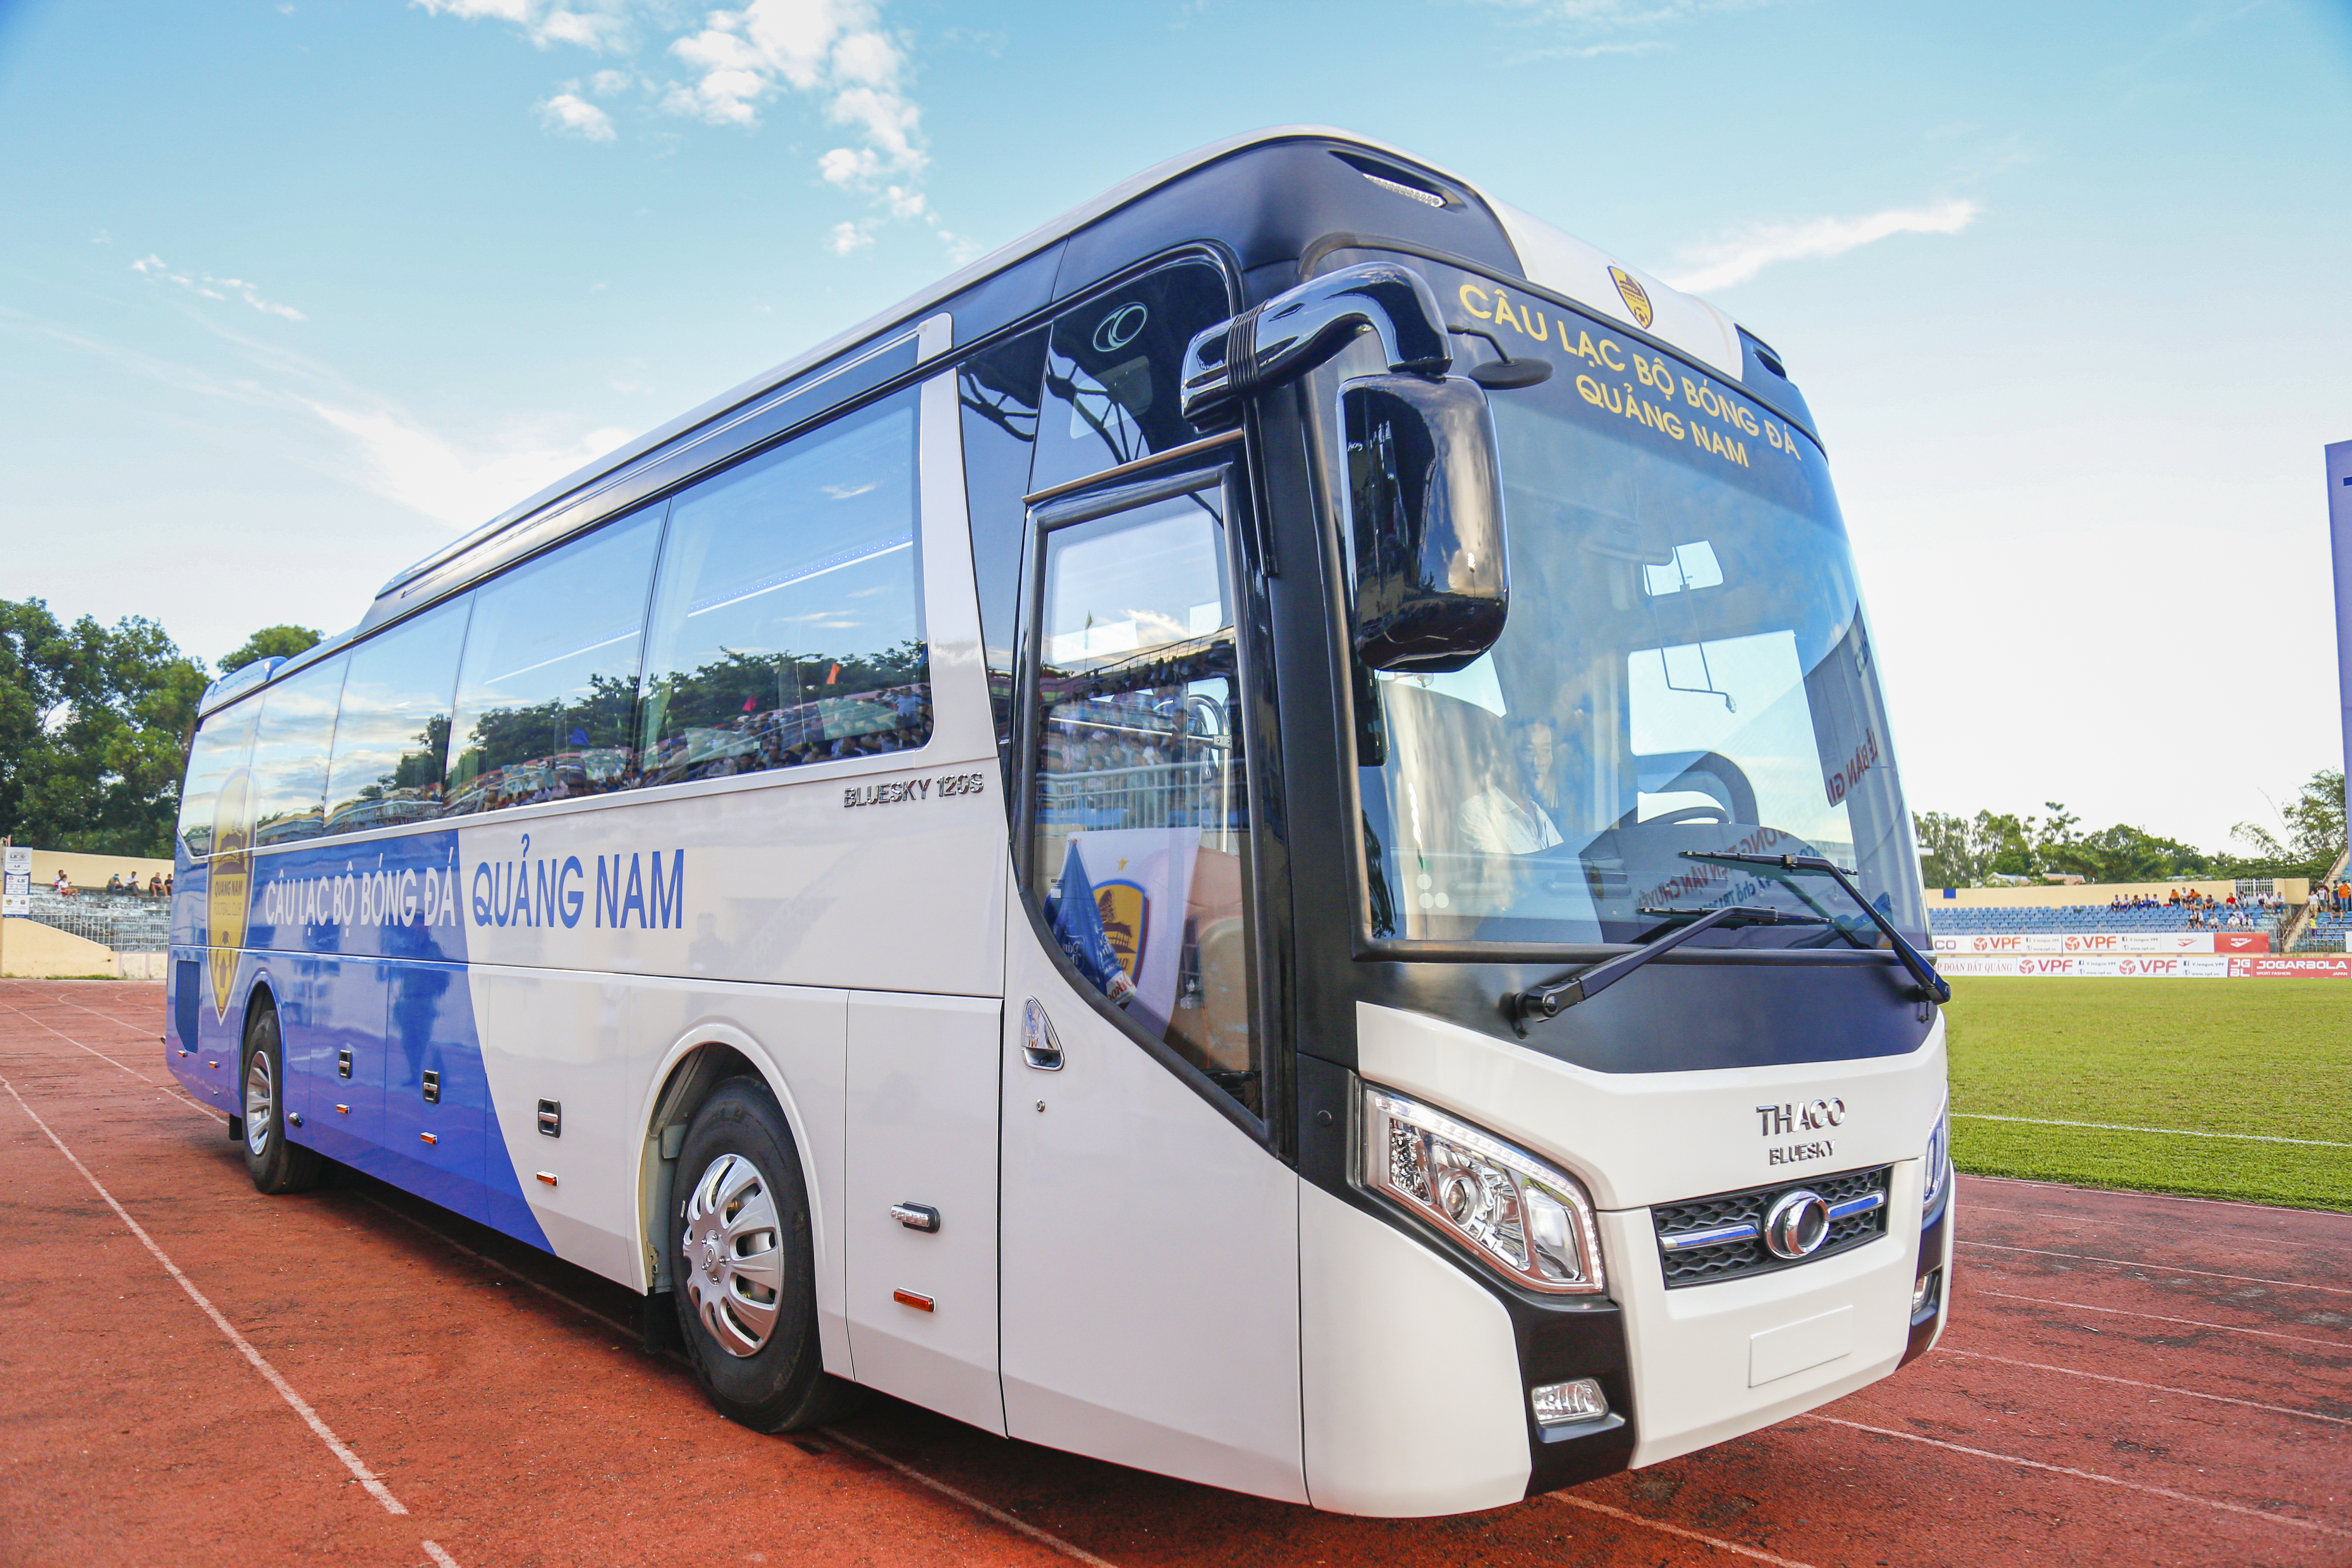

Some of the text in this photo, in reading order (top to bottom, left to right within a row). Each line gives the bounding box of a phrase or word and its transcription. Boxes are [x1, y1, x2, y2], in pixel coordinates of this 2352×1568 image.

[1459, 284, 1801, 461] CÂU LẠC BỘ BÓNG ĐÁ
[1576, 374, 1749, 468] QUẢNG NAM
[844, 771, 984, 808] BLUESKY 120S
[266, 833, 684, 937] CÂU LẠC BỘ BÓNG ĐÁ QUẢNG NAM
[1990, 937, 2021, 949] VPF
[2082, 936, 2116, 949] VPF
[2038, 959, 2073, 972] VPF
[2139, 960, 2177, 973] VPF
[2230, 959, 2251, 968] JG
[2257, 961, 2347, 969] JOGARBOLA
[2230, 968, 2250, 977] BL
[1756, 1097, 1846, 1136] THACO
[1769, 1139, 1836, 1166] BLUESKY
